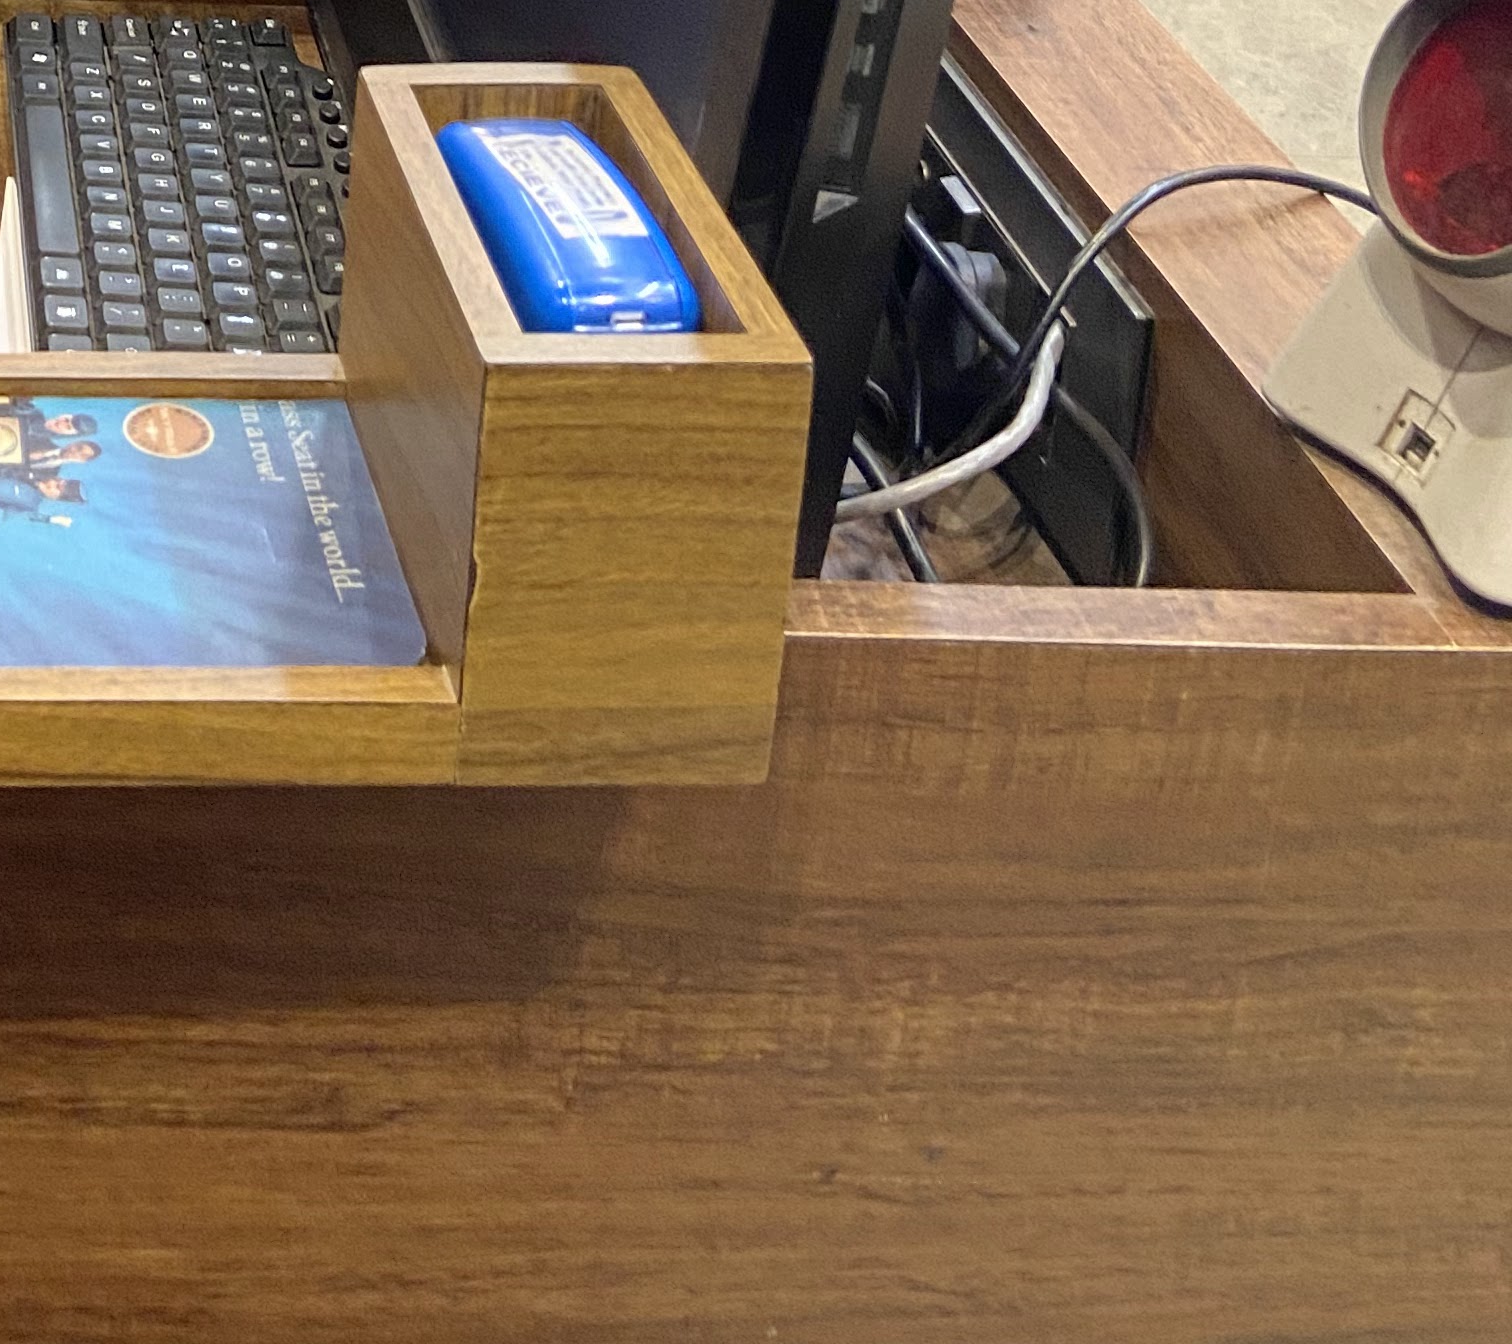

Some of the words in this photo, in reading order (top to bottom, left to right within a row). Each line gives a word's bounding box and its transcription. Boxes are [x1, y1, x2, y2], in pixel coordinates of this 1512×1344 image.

[244, 427, 265, 439] a
[249, 441, 287, 483] row!
[299, 471, 326, 492] in
[307, 495, 340, 528] the
